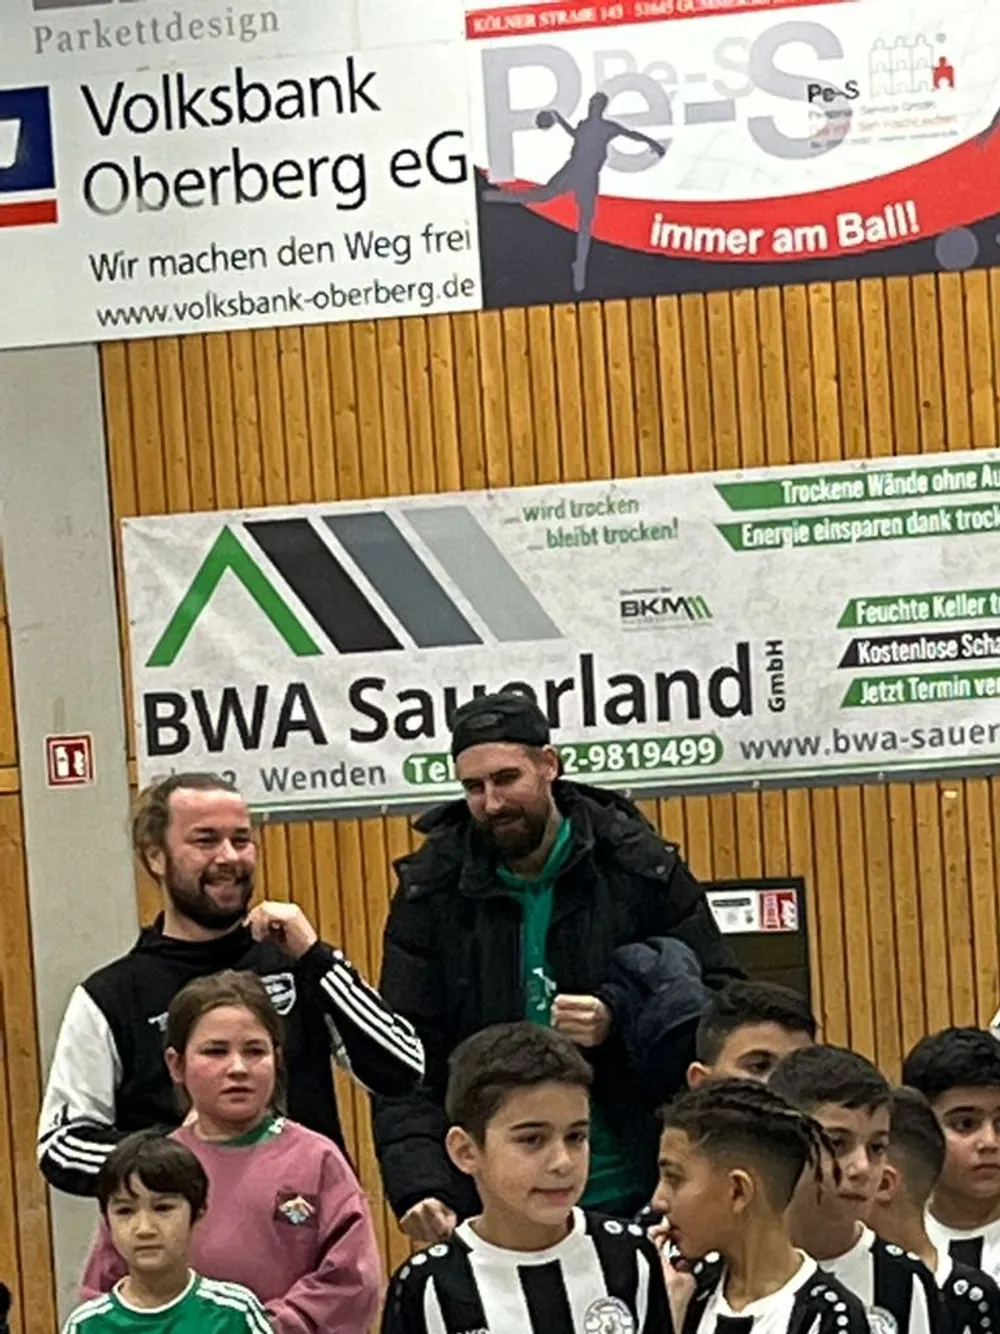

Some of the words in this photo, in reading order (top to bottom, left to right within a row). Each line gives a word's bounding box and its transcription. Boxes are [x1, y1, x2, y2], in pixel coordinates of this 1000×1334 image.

[34, 7, 280, 54] Parkettdesign
[81, 56, 381, 137] Volksbank
[83, 148, 367, 216] Oberberg
[390, 131, 468, 187] eG
[650, 212, 765, 255] immer
[772, 223, 828, 253] am
[836, 200, 920, 248] Ball!
[89, 251, 140, 283] Wir
[149, 242, 267, 278] machen
[277, 236, 335, 267] den
[344, 229, 411, 265] Weg
[420, 222, 471, 253] frei
[96, 273, 475, 327] www.volksbank-oberberg.de
[570, 495, 639, 519] trocken
[781, 477, 864, 504] Trockene
[867, 469, 928, 497] Wände
[932, 468, 977, 491] ohne
[602, 516, 679, 545] trocken!
[742, 520, 809, 548] Energie
[813, 517, 903, 544] einsparen
[906, 510, 951, 535] dank
[620, 597, 695, 621] BKM
[856, 598, 930, 625] Feuchte
[933, 593, 986, 618] Keller
[857, 637, 958, 664] Kostenlose
[143, 683, 329, 757] BWA
[765, 640, 786, 713] GmbH
[861, 678, 904, 704] Jetzt
[908, 674, 971, 701] Termin
[260, 762, 386, 792] Wenden
[560, 737, 717, 772] 2-9819499
